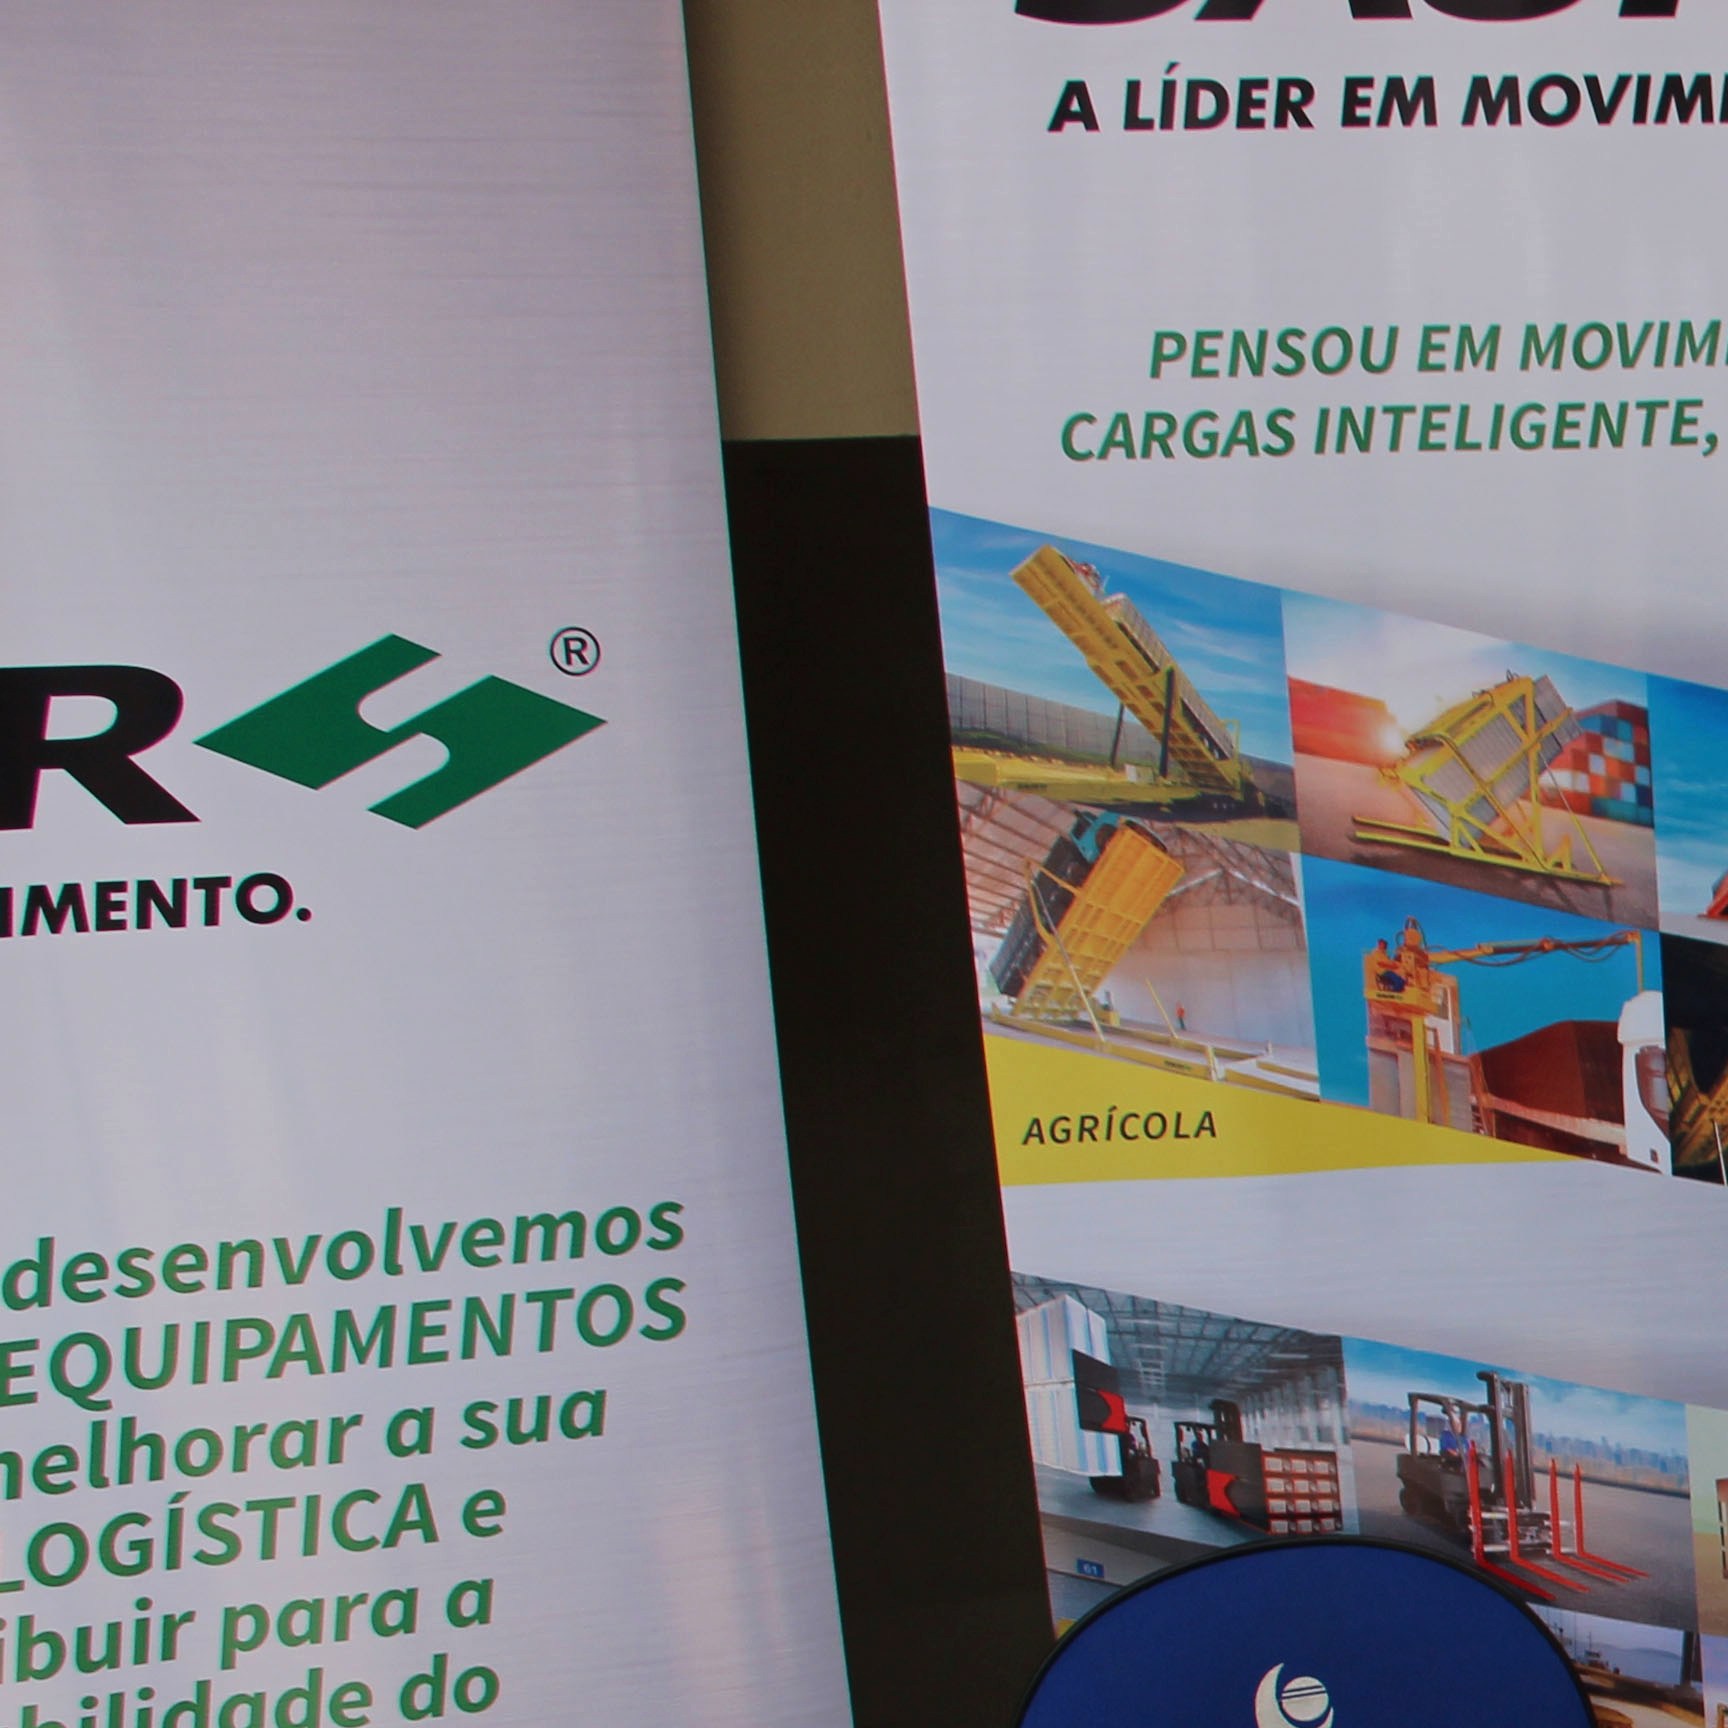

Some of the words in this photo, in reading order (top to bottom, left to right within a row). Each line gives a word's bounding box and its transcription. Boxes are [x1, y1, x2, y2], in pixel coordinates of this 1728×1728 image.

[1049, 79, 1101, 132] A
[1122, 63, 1316, 132] LÍDER
[1340, 76, 1439, 129] EM
[1148, 324, 1401, 380] PENSOU
[1416, 321, 1501, 375] EM
[1058, 406, 1297, 462] CARGAS
[1312, 398, 1722, 459] INTELIGENTE,
[1022, 1104, 1218, 1147] AGRÍCOLA
[2, 1200, 687, 1310] desenvolvemos
[0, 1276, 688, 1412] EQUIPAMENTOS
[385, 1403, 435, 1459] a
[459, 1386, 608, 1451] sua
[461, 1484, 508, 1539] e
[220, 1584, 420, 1671] para
[445, 1576, 495, 1629] a
[398, 1651, 501, 1724] do
